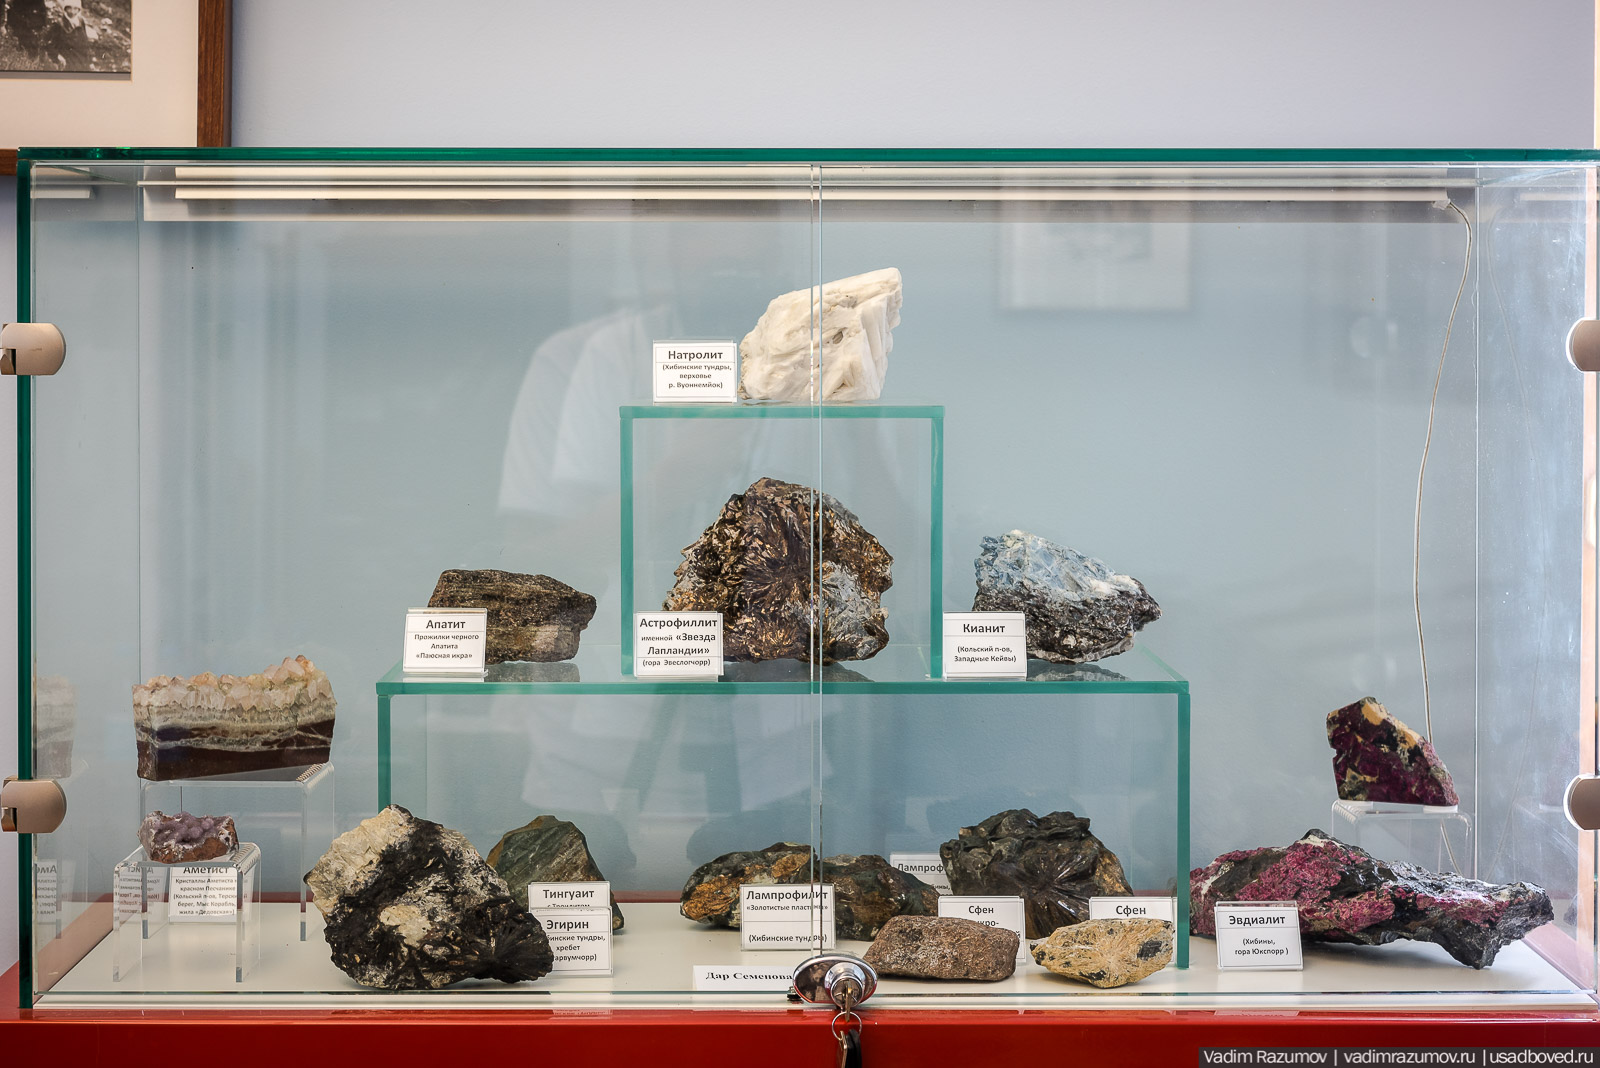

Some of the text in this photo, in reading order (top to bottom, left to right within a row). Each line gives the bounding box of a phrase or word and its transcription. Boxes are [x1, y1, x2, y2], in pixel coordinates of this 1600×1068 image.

[668, 350, 723, 361] Натролит
[426, 619, 466, 629] Апатит
[639, 618, 718, 629] Астрофиллит
[963, 624, 1005, 633] Кианит
[676, 632, 716, 642] «Звезда
[647, 647, 710, 655] Лапландии»
[897, 863, 944, 873] Лампроф
[543, 889, 595, 900] Тингуаит
[746, 890, 828, 901] Лампрофилит
[968, 905, 994, 915] Сфен
[1116, 905, 1146, 917] Сфен
[546, 920, 589, 931] Эгирин
[1229, 915, 1285, 926] Эвдиалит
[748, 934, 827, 942] (Хибинские тундры)
[556, 944, 580, 952] хребет
[706, 972, 793, 980] Дар Семенова
